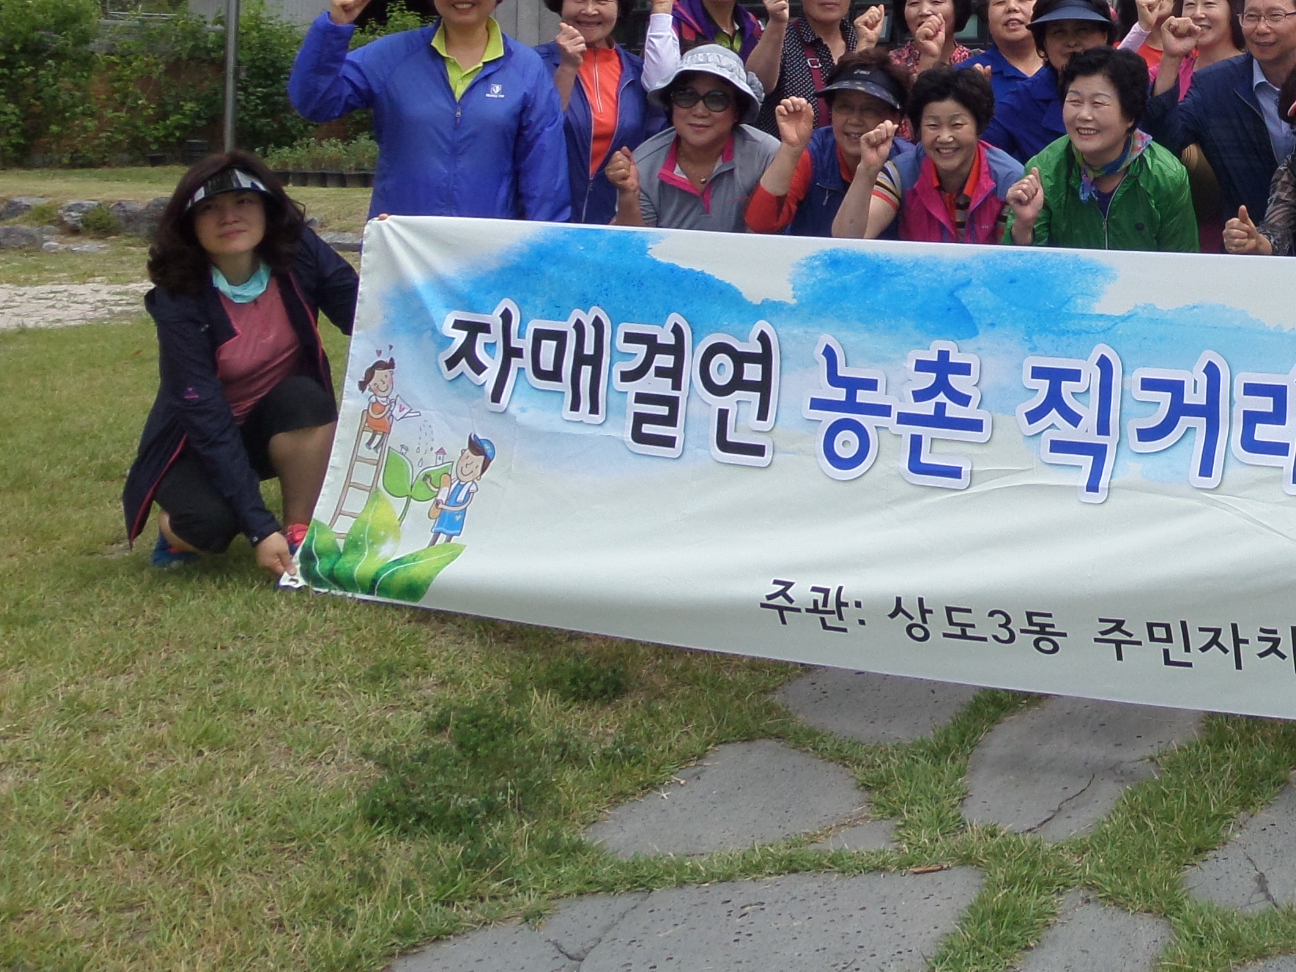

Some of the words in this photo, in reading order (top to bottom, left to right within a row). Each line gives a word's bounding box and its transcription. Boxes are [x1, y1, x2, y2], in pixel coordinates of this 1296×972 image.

[441, 304, 777, 461] 자매결연
[807, 341, 985, 482] 농촌
[759, 578, 867, 634] 주관:
[887, 595, 1068, 656] 상도3동
